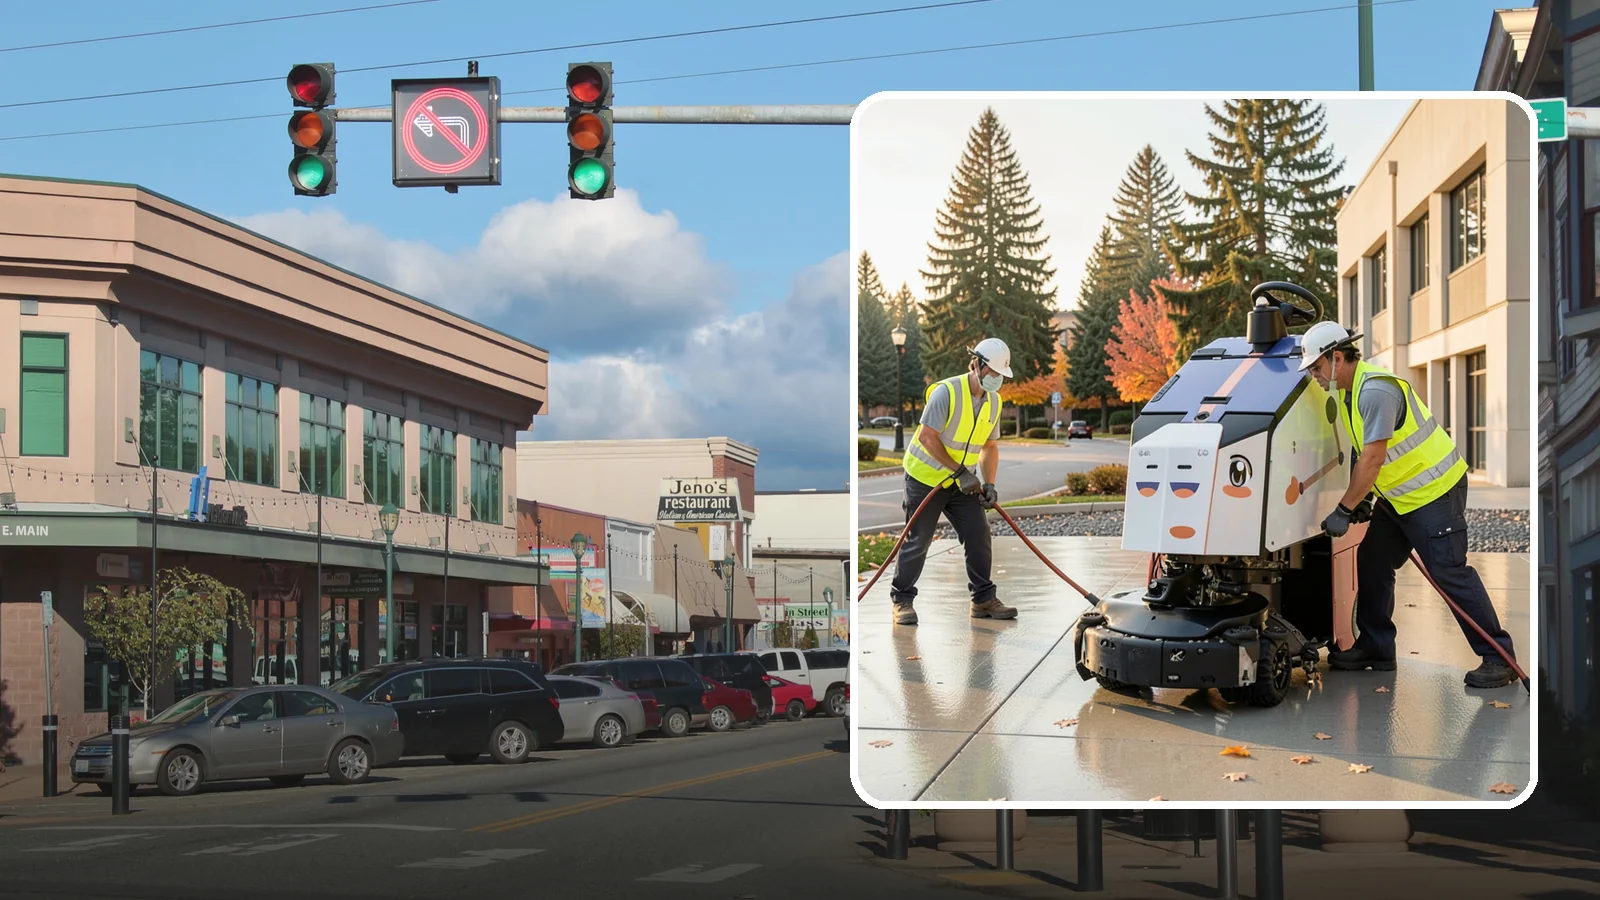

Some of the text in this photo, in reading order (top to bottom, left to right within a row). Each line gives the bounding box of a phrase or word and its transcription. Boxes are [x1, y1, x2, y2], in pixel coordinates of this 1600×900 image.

[669, 480, 728, 494] Jeno's
[665, 496, 731, 509] restaurant
[658, 510, 681, 519] Italian
[686, 509, 715, 519] American
[715, 509, 737, 519] Cuisine
[2, 525, 49, 536] E. MAIN
[797, 607, 828, 616] Street
